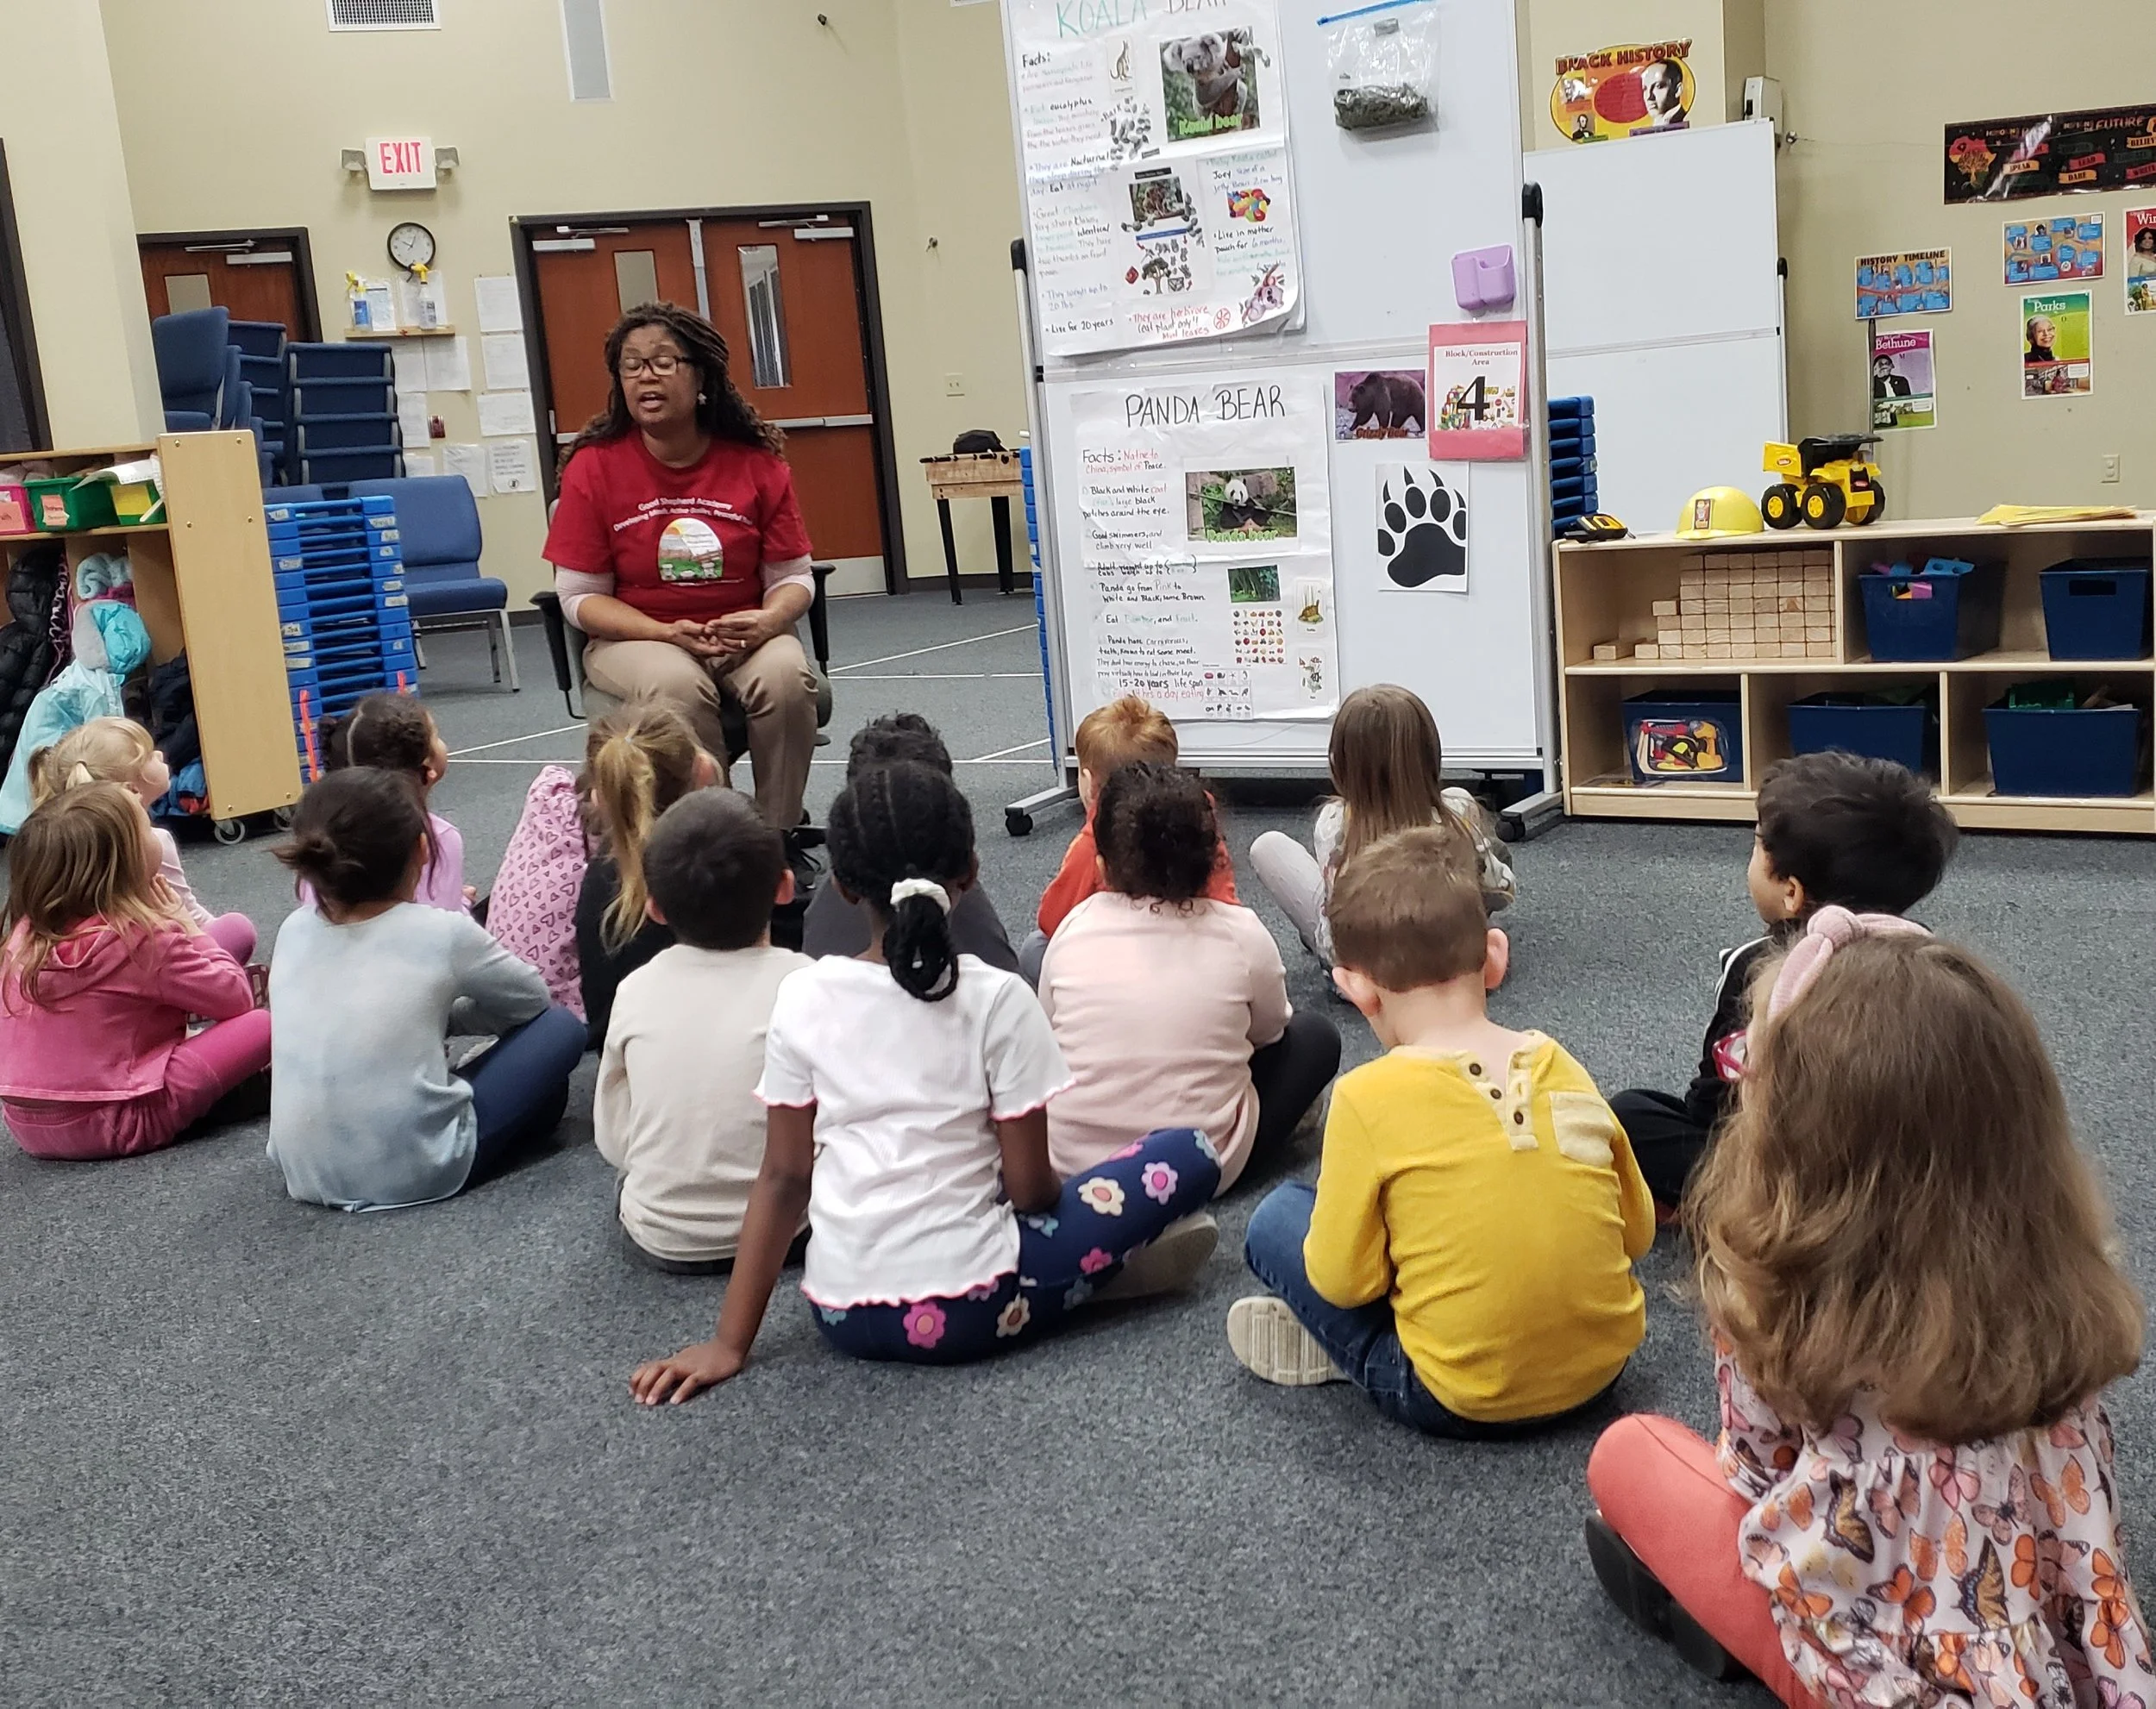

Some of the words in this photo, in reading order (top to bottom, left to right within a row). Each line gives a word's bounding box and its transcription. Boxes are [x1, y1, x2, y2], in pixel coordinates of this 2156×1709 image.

[1056, 0, 1147, 38] KOALA
[1021, 51, 1051, 68] Facts:
[1556, 53, 1613, 75] BLACK
[1616, 39, 1692, 65] HISTORY
[1050, 96, 1094, 112] eucalyptus
[379, 142, 421, 173] EXIT
[1070, 151, 1110, 167] Nocturnal
[1212, 170, 1232, 180] Joey
[1218, 228, 1234, 241] Live
[1236, 228, 1246, 237] in
[1247, 224, 1275, 236] mother
[1236, 240, 1249, 250] for
[1860, 254, 1898, 266] HISTORY
[1903, 249, 1946, 262] TIMELINE
[2034, 299, 2066, 312] Parks
[1132, 312, 1150, 323] They
[1152, 312, 1166, 321] are
[1050, 323, 1067, 335] Live
[1068, 321, 1078, 332] for
[1081, 320, 1093, 331] 20
[1092, 317, 1115, 331] years
[1875, 338, 1916, 350] Bethune
[1445, 348, 1519, 358] Block/Construction
[1457, 376, 1490, 421] 4
[1125, 393, 1200, 428] PANDA
[1214, 385, 1286, 421] BEAR
[1090, 485, 1112, 495] Black
[1135, 496, 1156, 505] black
[1137, 507, 1150, 516] the
[1134, 540, 1152, 550] well
[1099, 582, 1124, 592] Panda
[1126, 585, 1136, 595] go
[1137, 582, 1153, 592] from
[1174, 581, 1181, 590] to
[1106, 614, 1119, 623] Eat
[1157, 614, 1173, 623] and
[1119, 678, 1145, 688] 15-20
[1146, 678, 1169, 690] years
[1175, 678, 1187, 688] life
[1188, 679, 1203, 690] span
[1143, 688, 1155, 698] hrs
[1164, 688, 1179, 703] day
[1181, 689, 1205, 702] eating
